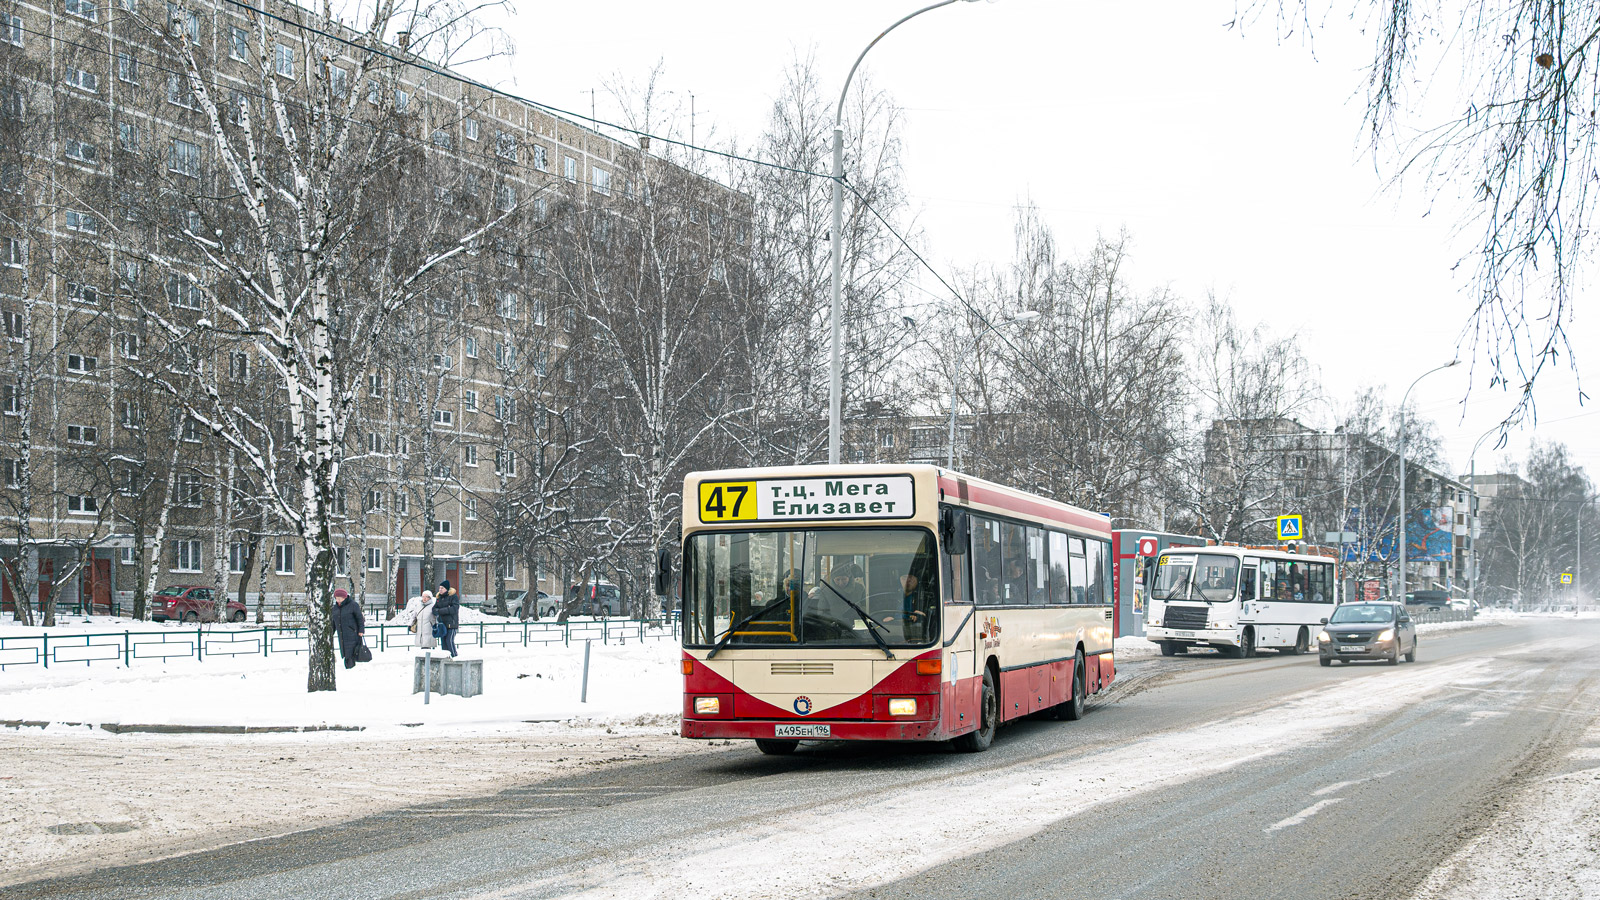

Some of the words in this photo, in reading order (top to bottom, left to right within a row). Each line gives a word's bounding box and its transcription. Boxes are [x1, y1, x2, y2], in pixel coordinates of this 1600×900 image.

[771, 485, 815, 499] т.ц.
[825, 481, 889, 496] Мега
[705, 486, 749, 518] 47
[772, 501, 896, 516] Елизавет
[814, 725, 829, 734] 196
